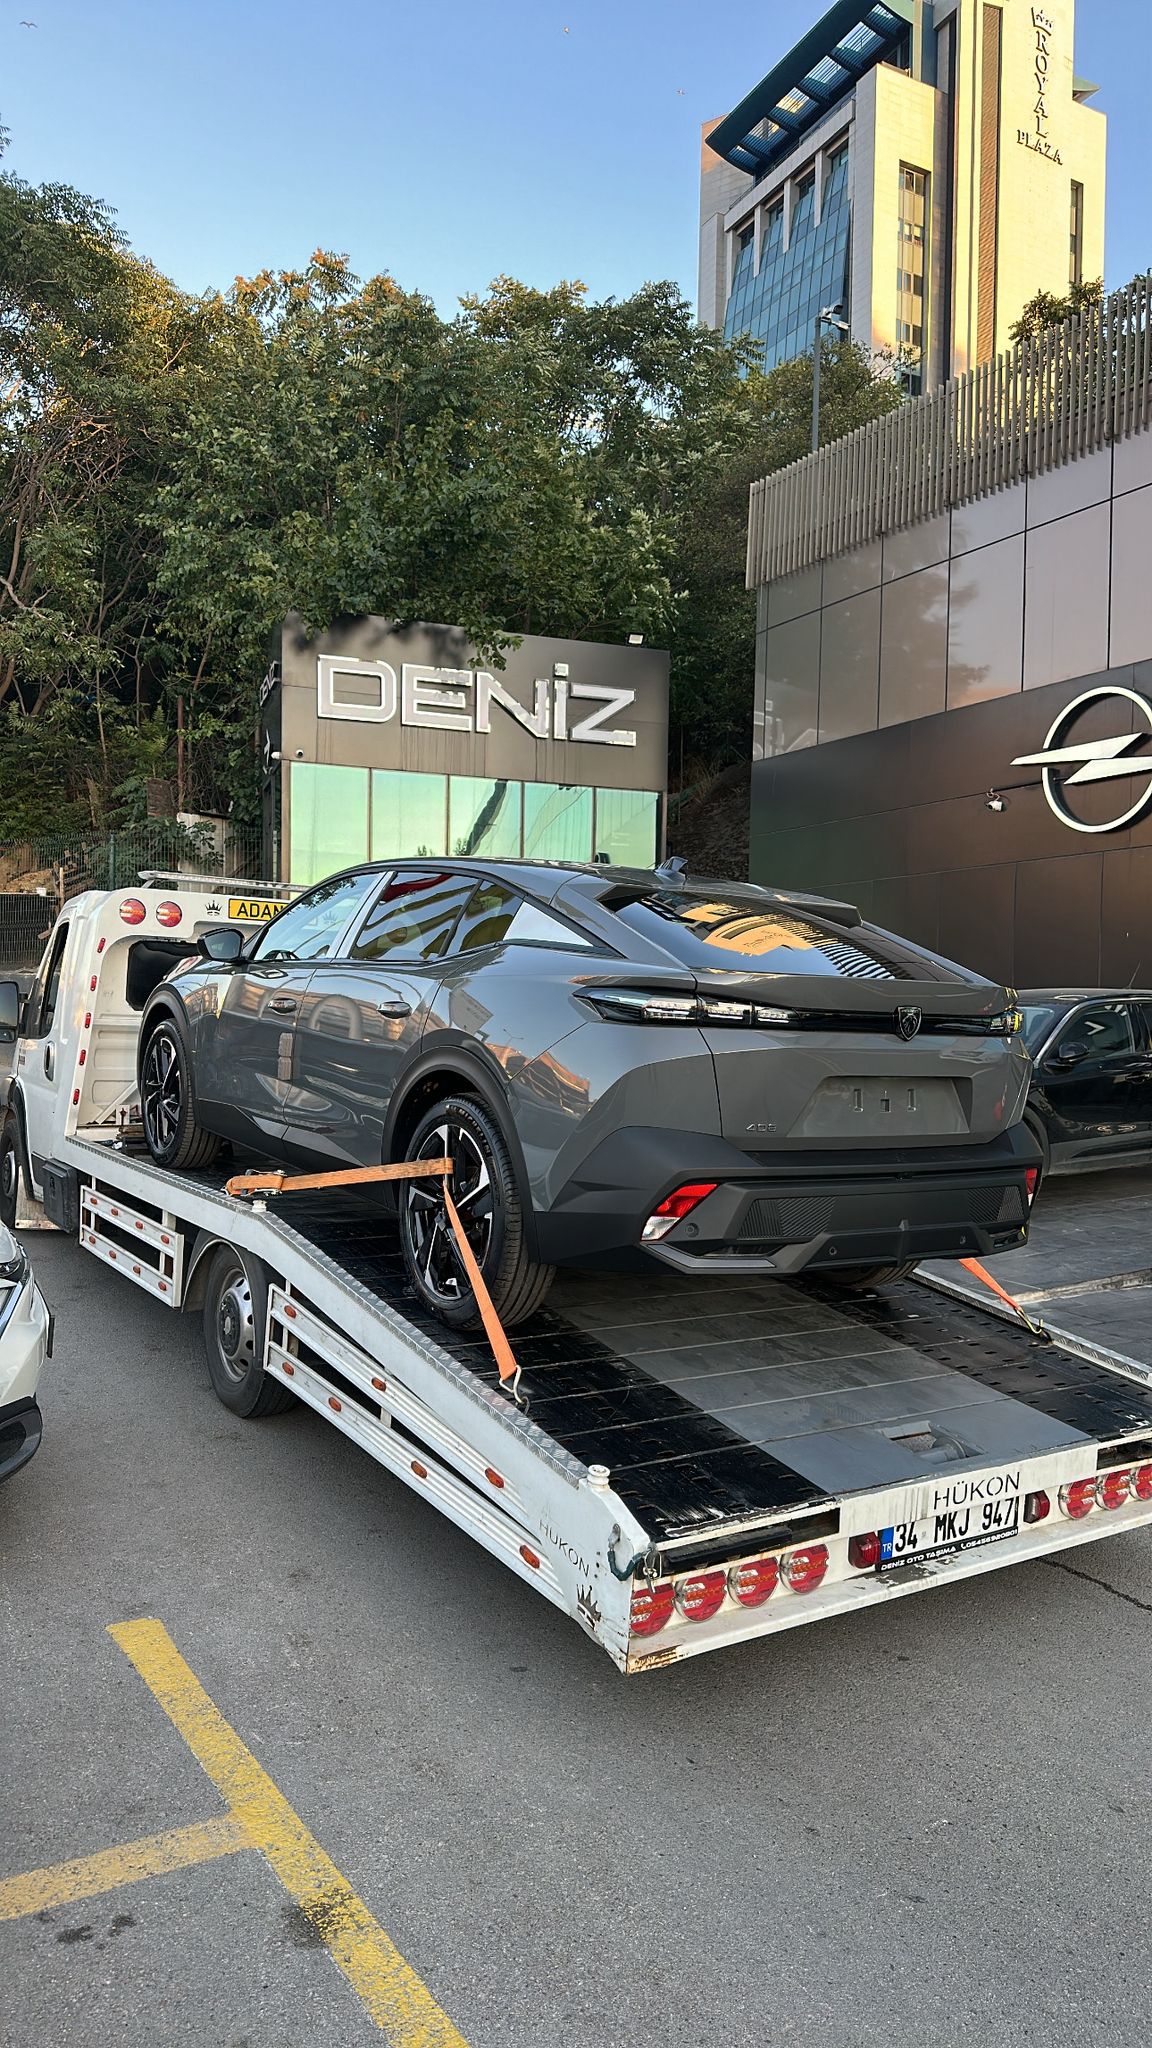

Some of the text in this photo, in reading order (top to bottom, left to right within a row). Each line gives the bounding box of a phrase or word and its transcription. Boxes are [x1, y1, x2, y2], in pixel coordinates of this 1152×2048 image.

[1033, 30, 1050, 138] ROYAL
[1017, 129, 1063, 166] PLAZA
[317, 653, 637, 746] DENİZ
[933, 1471, 1020, 1510] HÜKON
[882, 1498, 1015, 1553] TR 34 MKJ 947
[906, 1554, 925, 1564] OTO
